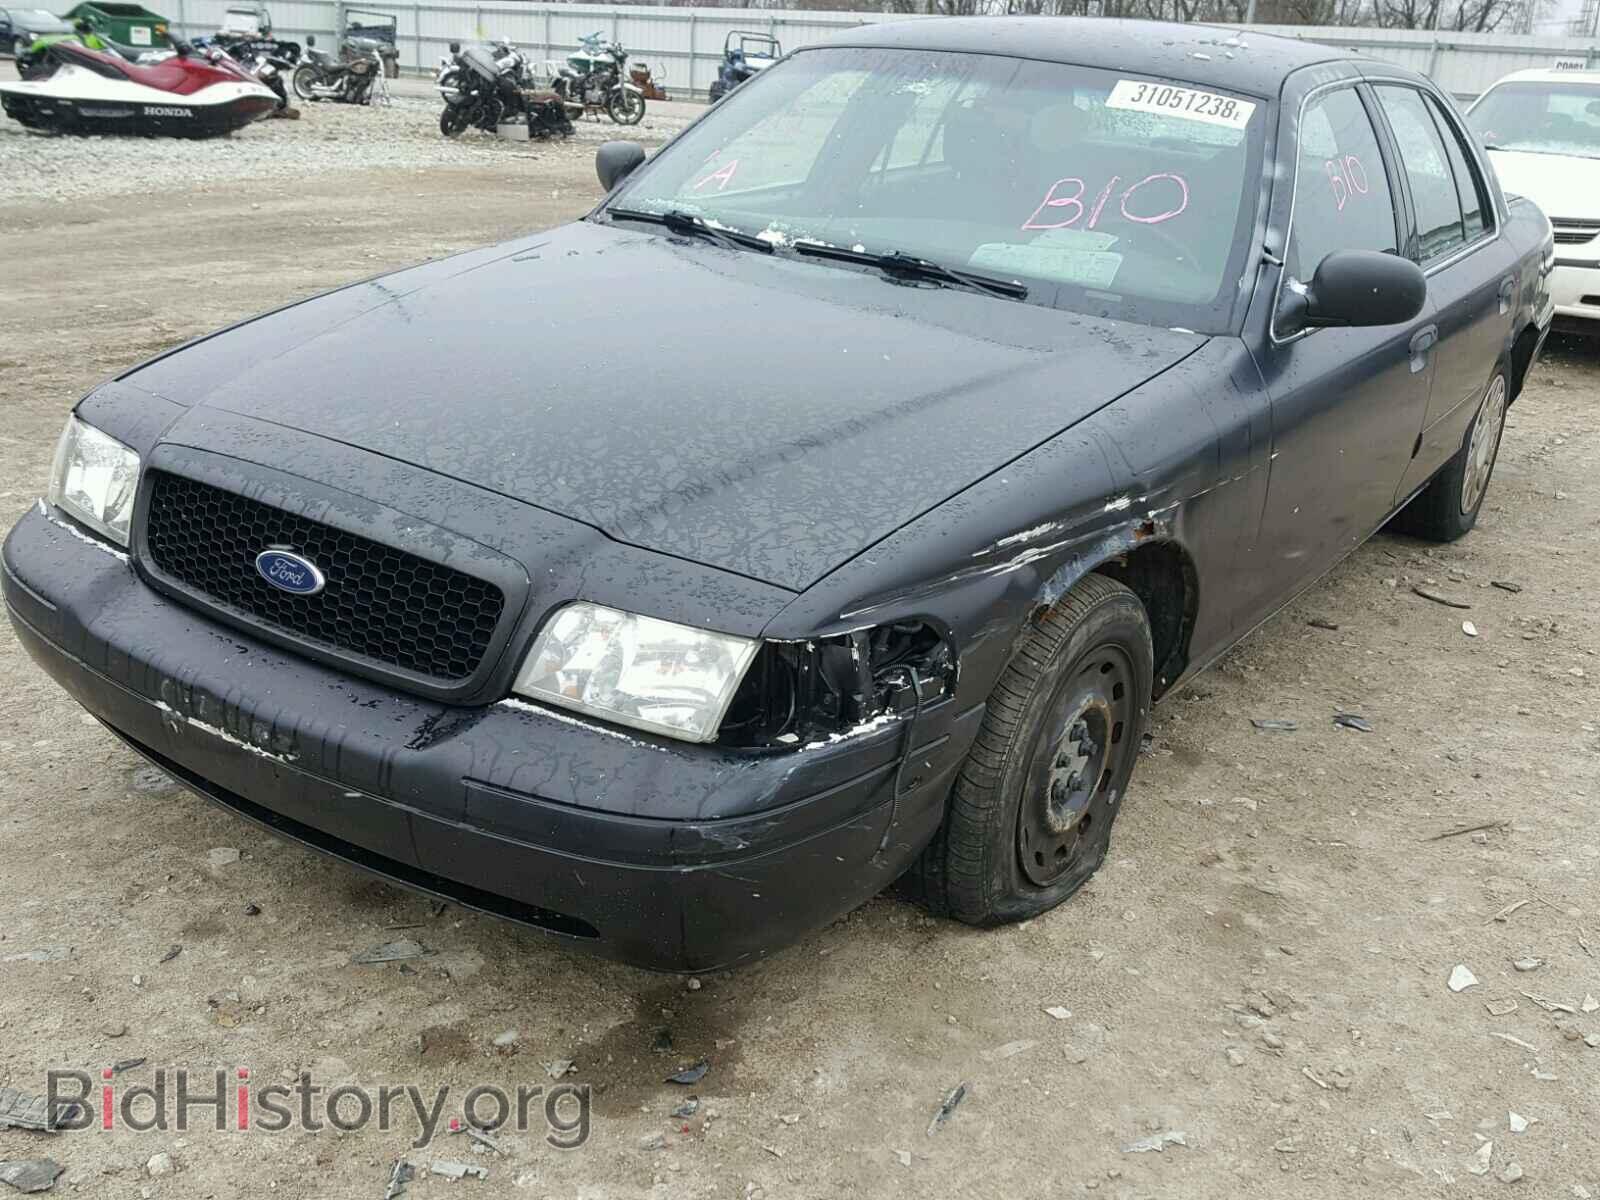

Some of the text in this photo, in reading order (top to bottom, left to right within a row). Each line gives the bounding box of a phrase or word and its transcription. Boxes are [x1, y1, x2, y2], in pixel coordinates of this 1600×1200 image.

[144, 106, 193, 117] HONDA
[1131, 84, 1237, 119] 31051238
[270, 558, 305, 585] Ford
